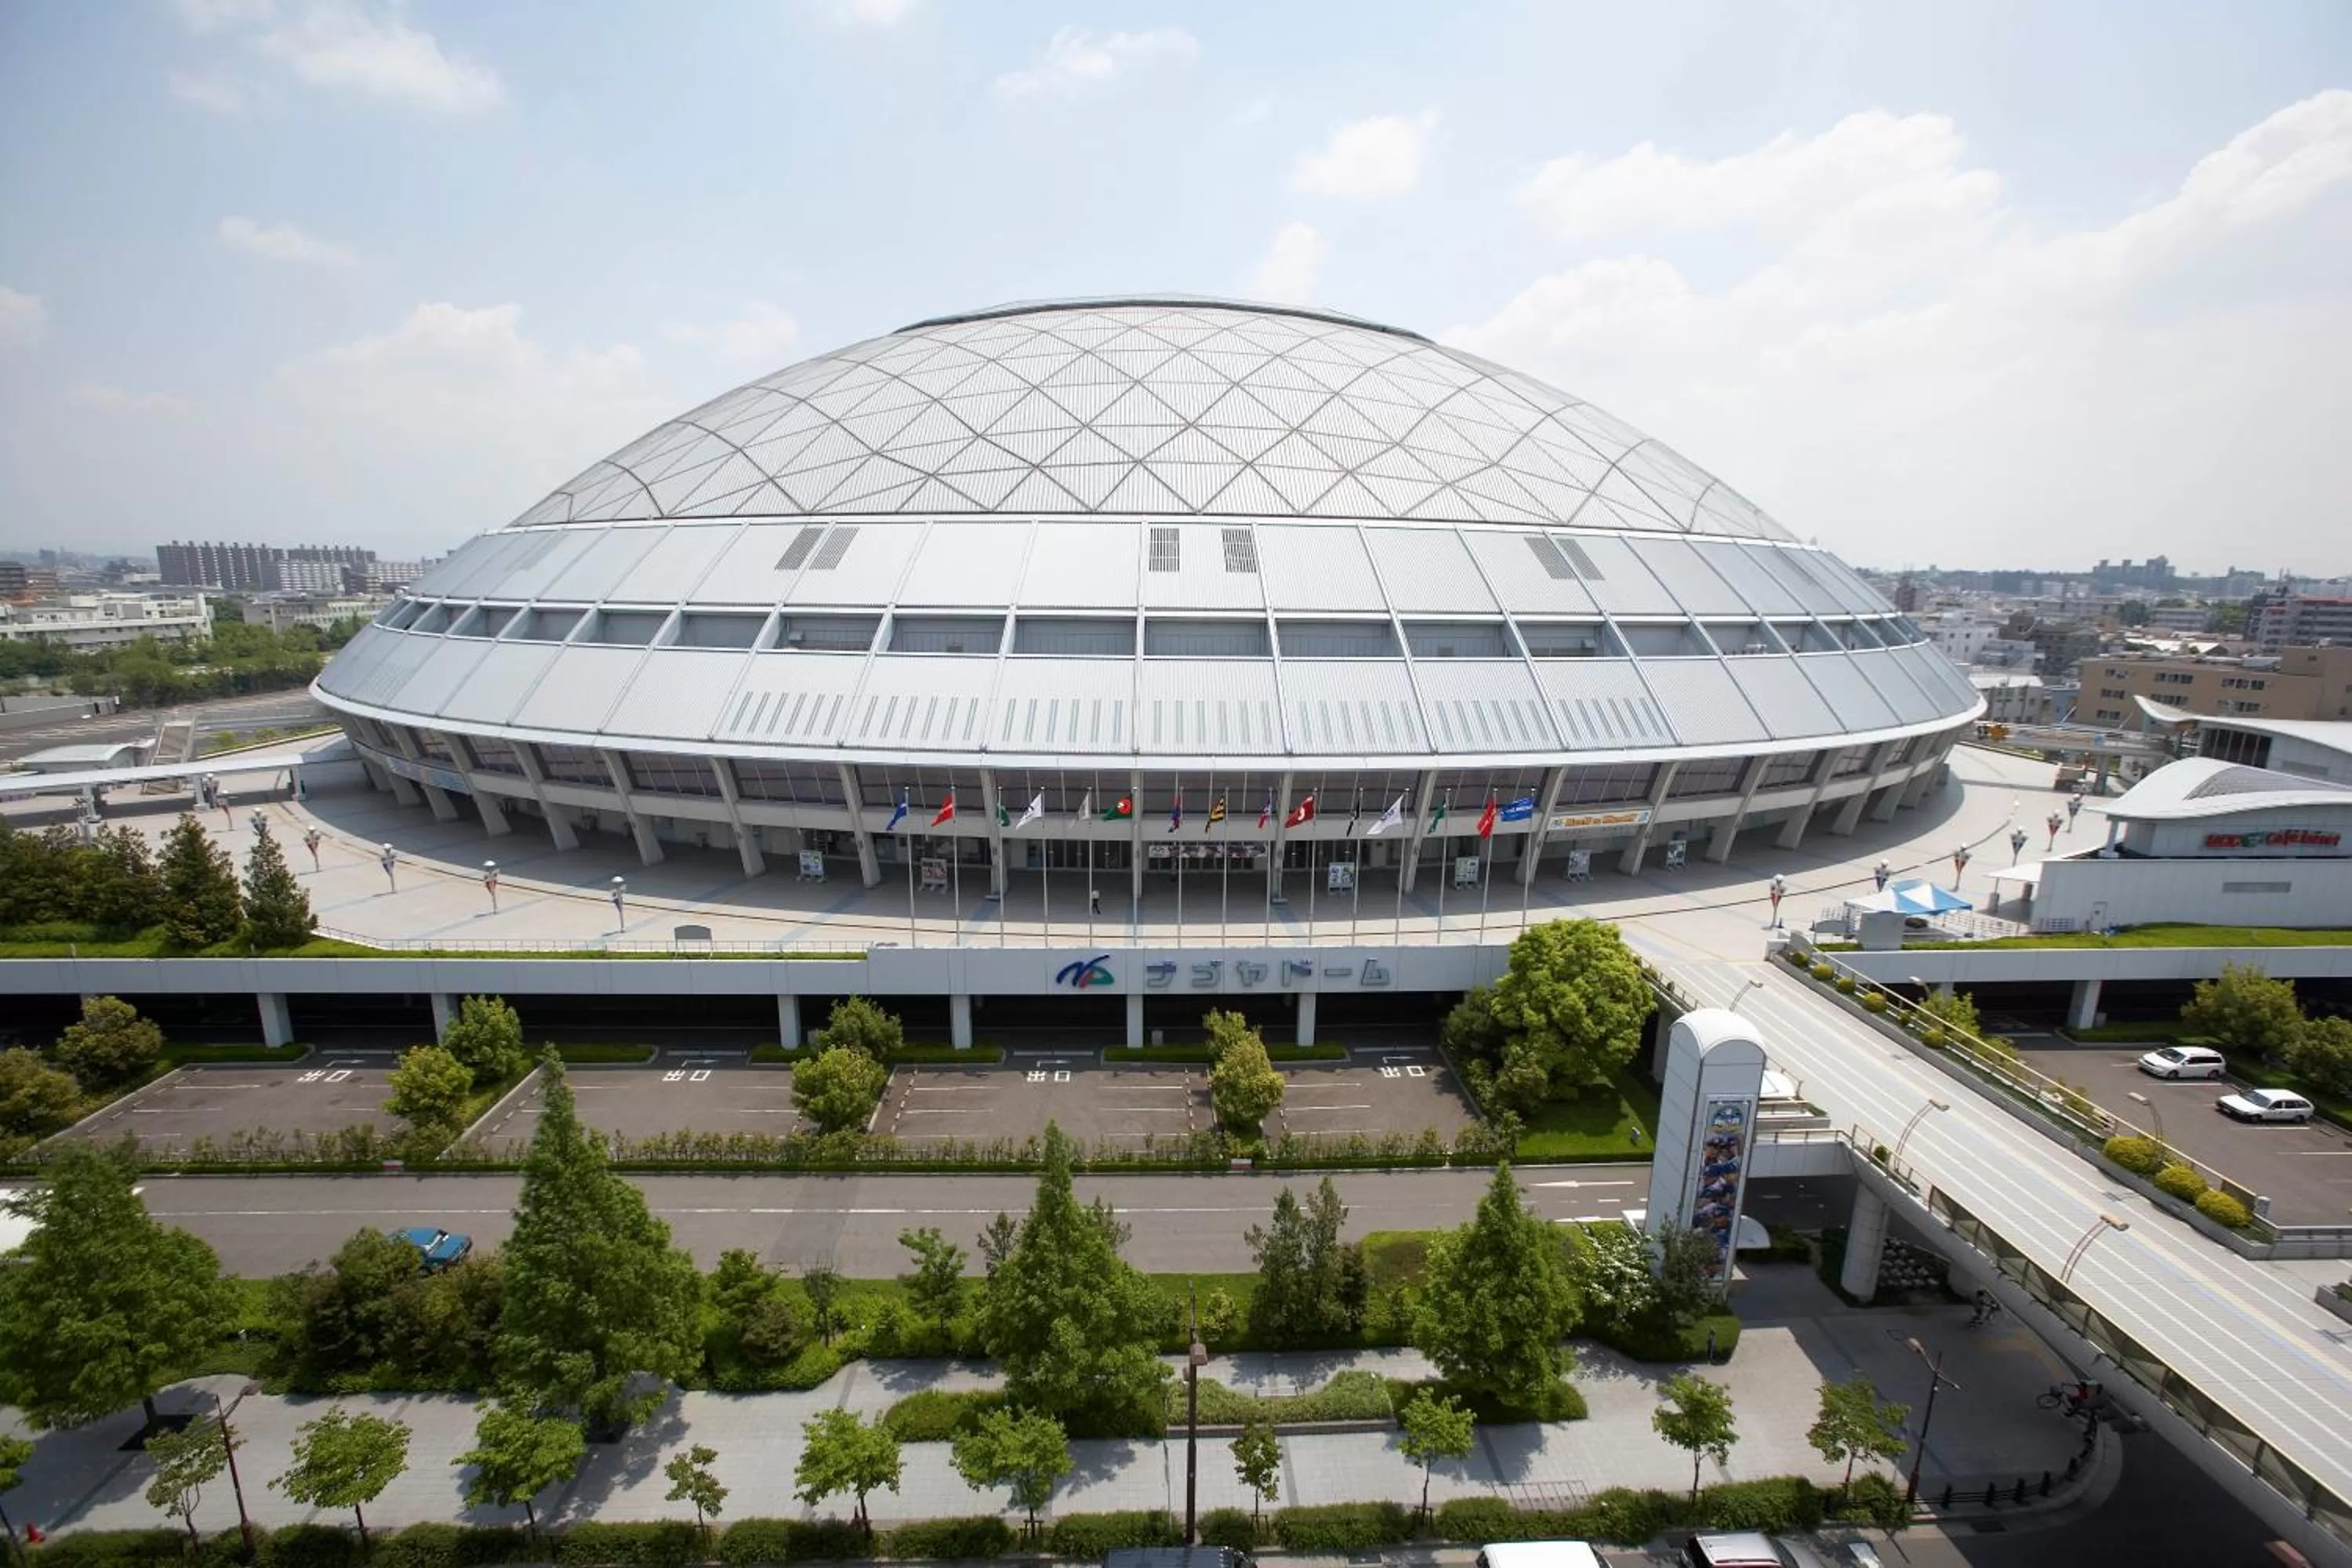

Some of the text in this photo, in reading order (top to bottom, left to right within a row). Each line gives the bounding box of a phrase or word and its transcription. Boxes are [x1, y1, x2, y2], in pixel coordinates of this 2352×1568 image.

[1147, 958, 1390, 988] ナゴヤドーム
[296, 1069, 353, 1083] 出口
[662, 1069, 712, 1082] 出口
[1026, 1070, 1071, 1083] 出口
[1380, 1065, 1425, 1078] 出口
